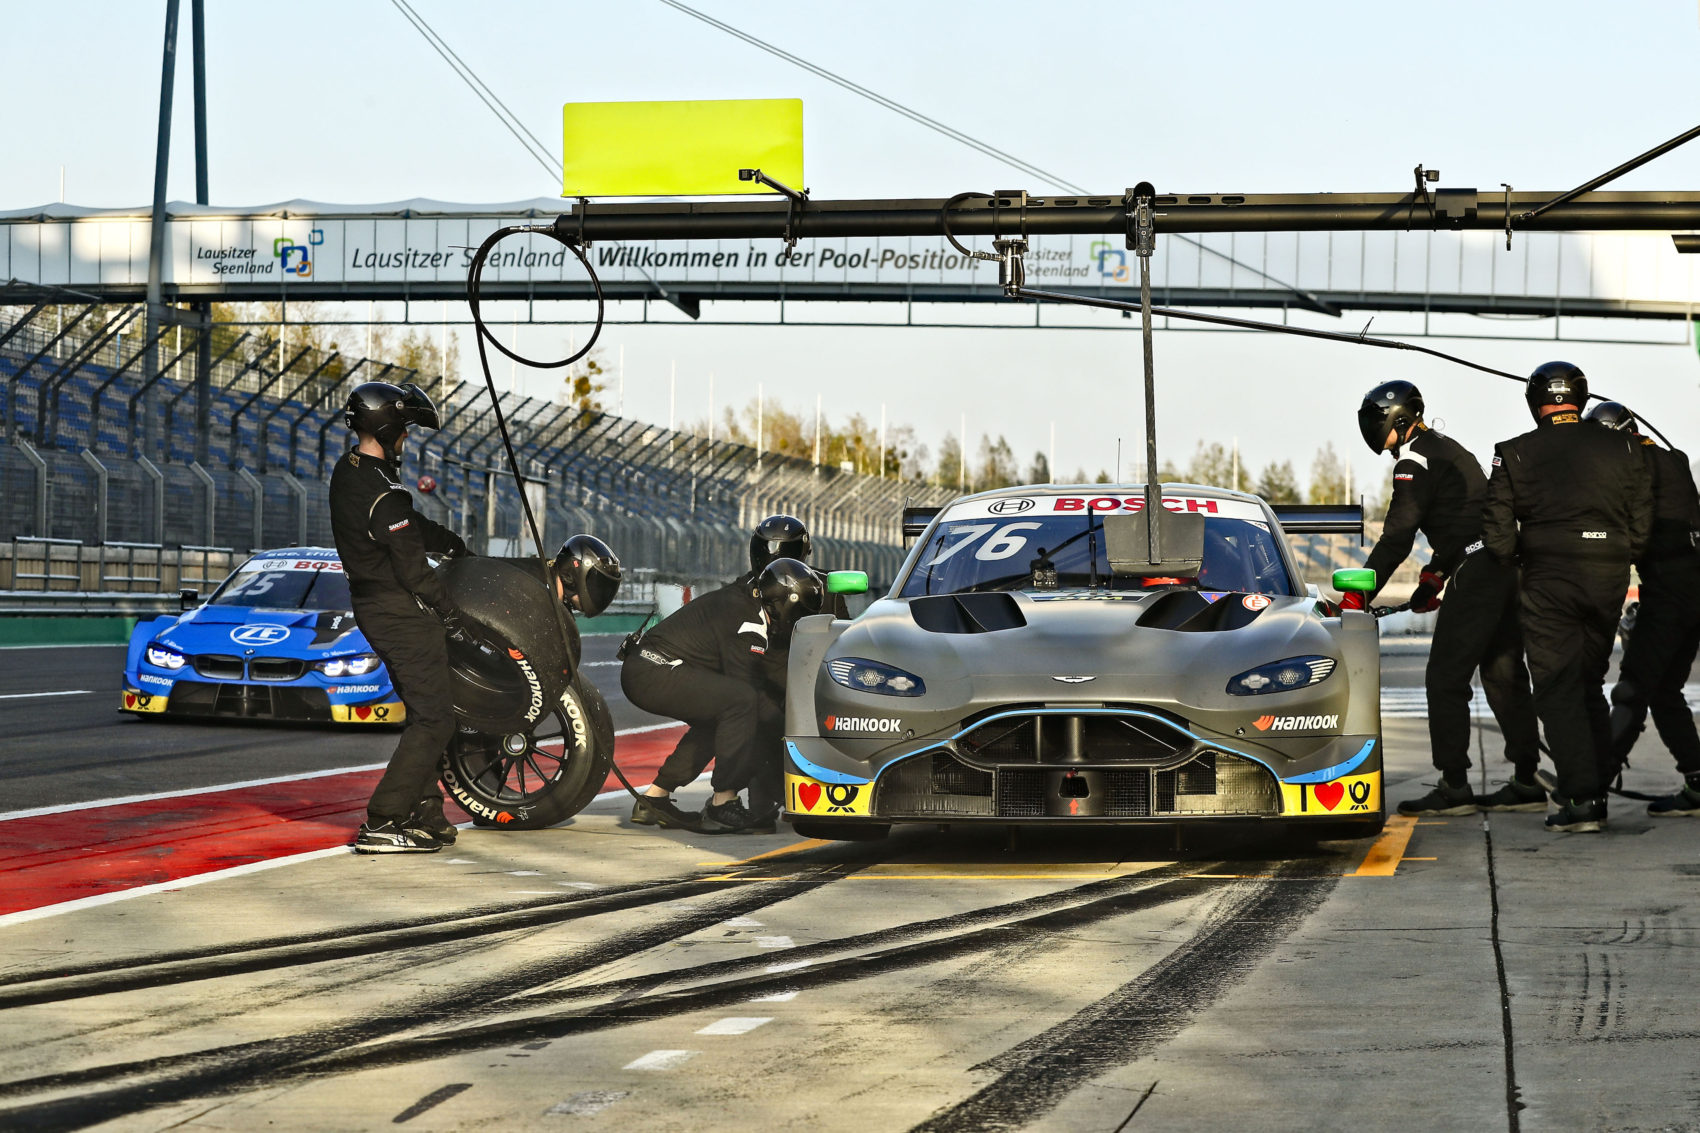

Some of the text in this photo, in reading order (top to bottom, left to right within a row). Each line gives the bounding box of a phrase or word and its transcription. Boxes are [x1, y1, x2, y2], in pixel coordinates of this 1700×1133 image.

[197, 247, 258, 260] Lausitzer
[352, 247, 454, 269] Lausitzer
[460, 246, 567, 268] Senland
[599, 246, 739, 267] Willkommen
[746, 247, 768, 267] in
[774, 250, 815, 267] der
[1025, 248, 1073, 261] usitzer
[212, 261, 274, 275] Seenland
[1025, 263, 1090, 277] Seenland
[926, 521, 1044, 566] 76
[1464, 539, 1484, 554] spar
[294, 560, 343, 571] BOS
[220, 573, 286, 597] 25
[236, 626, 281, 642] ZF
[640, 649, 668, 665] sparc
[560, 692, 588, 750] KOOK
